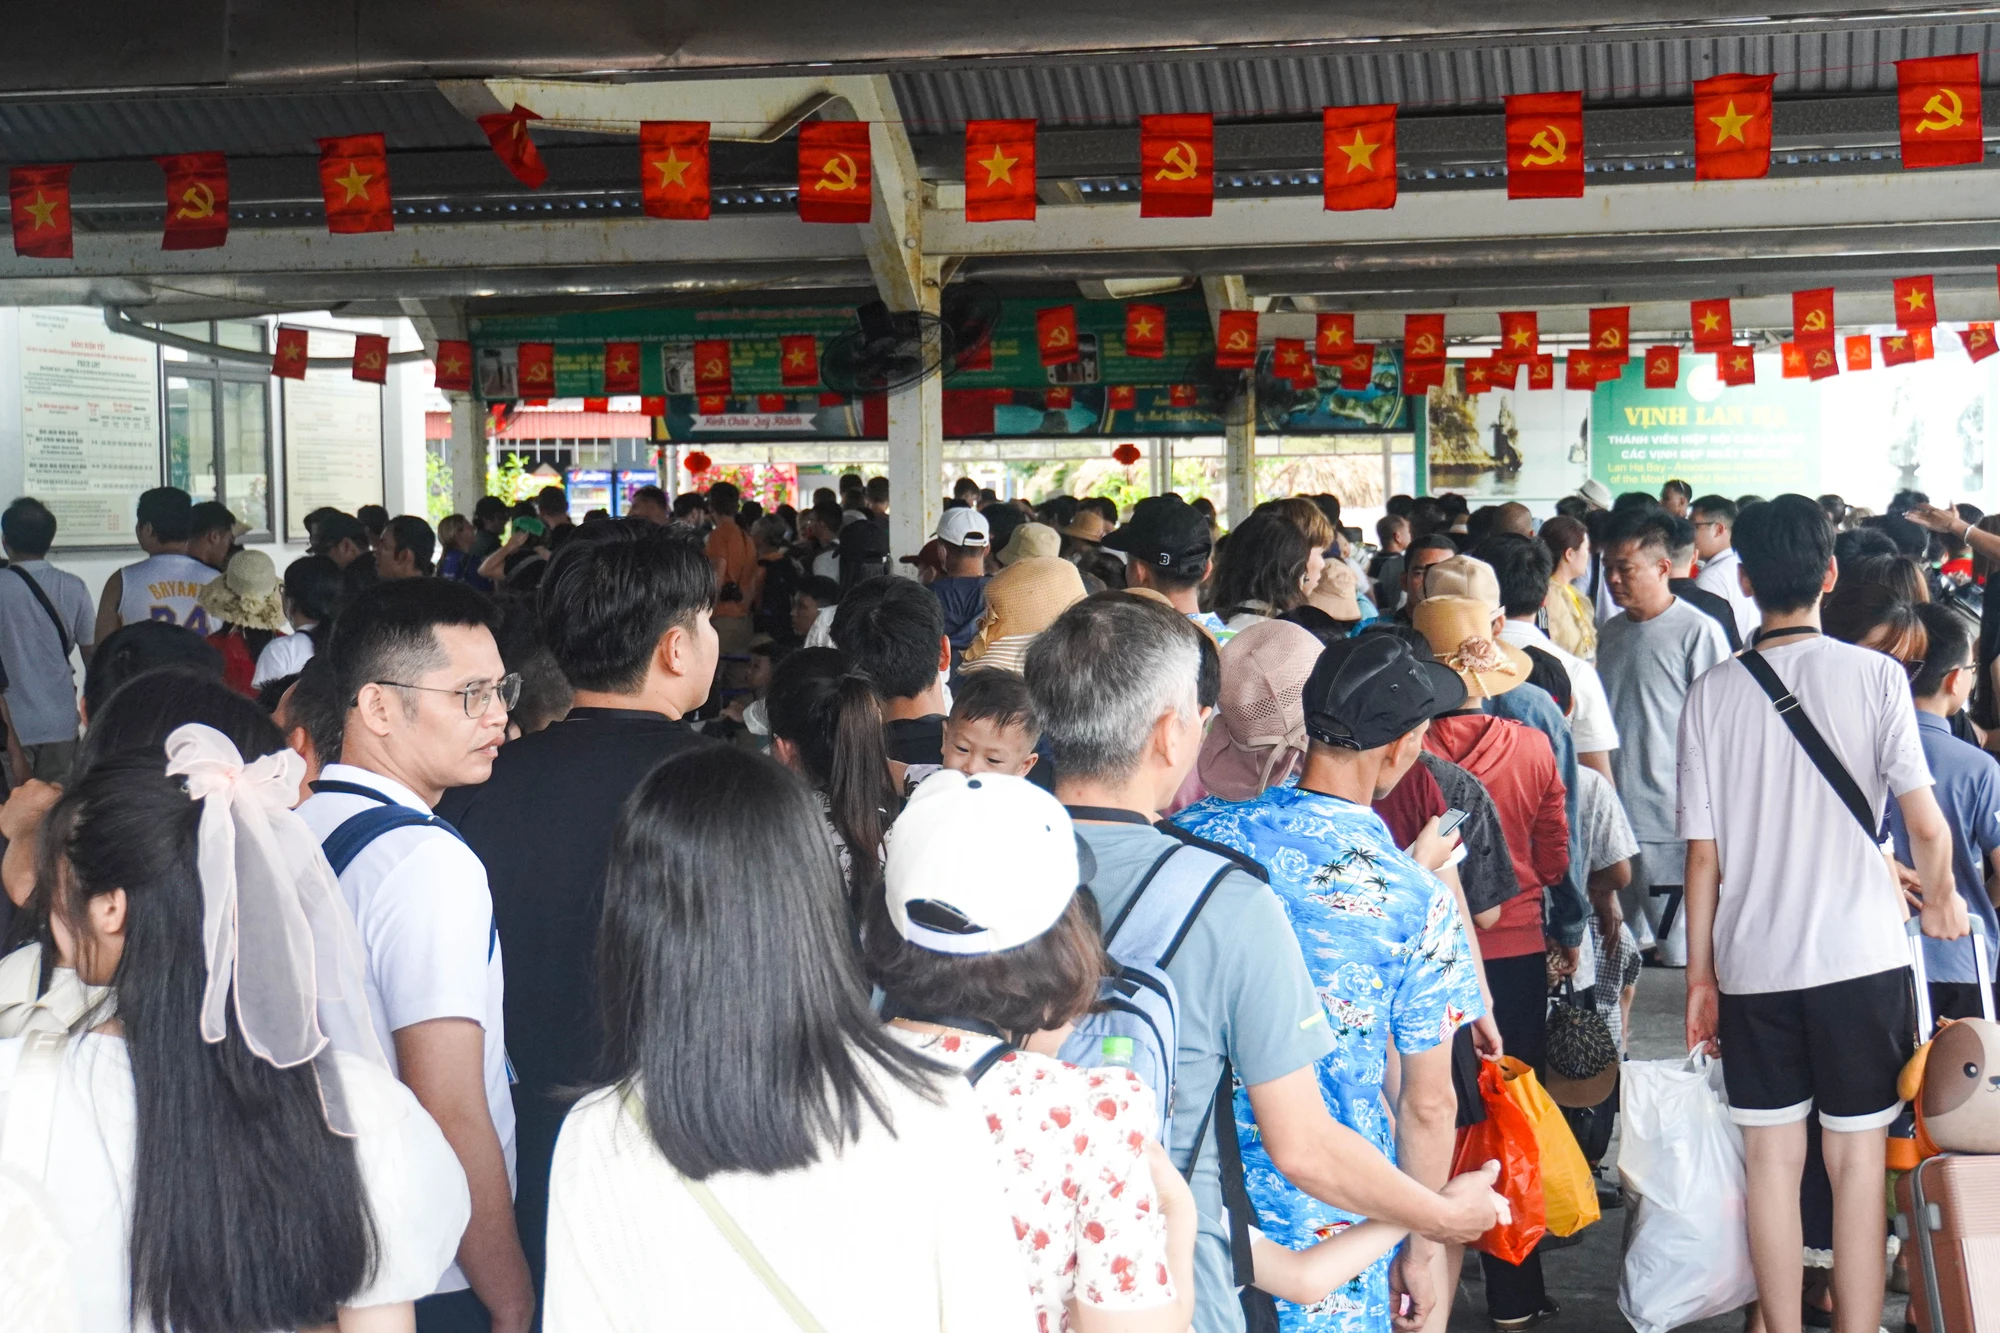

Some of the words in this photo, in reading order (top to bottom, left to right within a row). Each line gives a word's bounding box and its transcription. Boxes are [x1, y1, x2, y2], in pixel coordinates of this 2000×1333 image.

[1624, 407, 1687, 428] VỊNH
[1696, 407, 1744, 426] LAN
[1649, 449, 1677, 461] VỊNH
[1608, 462, 1627, 472] Lan
[1629, 462, 1644, 472] Ha
[1646, 462, 1666, 474] Bay
[1610, 474, 1621, 483] of
[1623, 474, 1639, 483] the
[148, 581, 199, 600] BRYAN
[1649, 885, 1684, 940] 7
